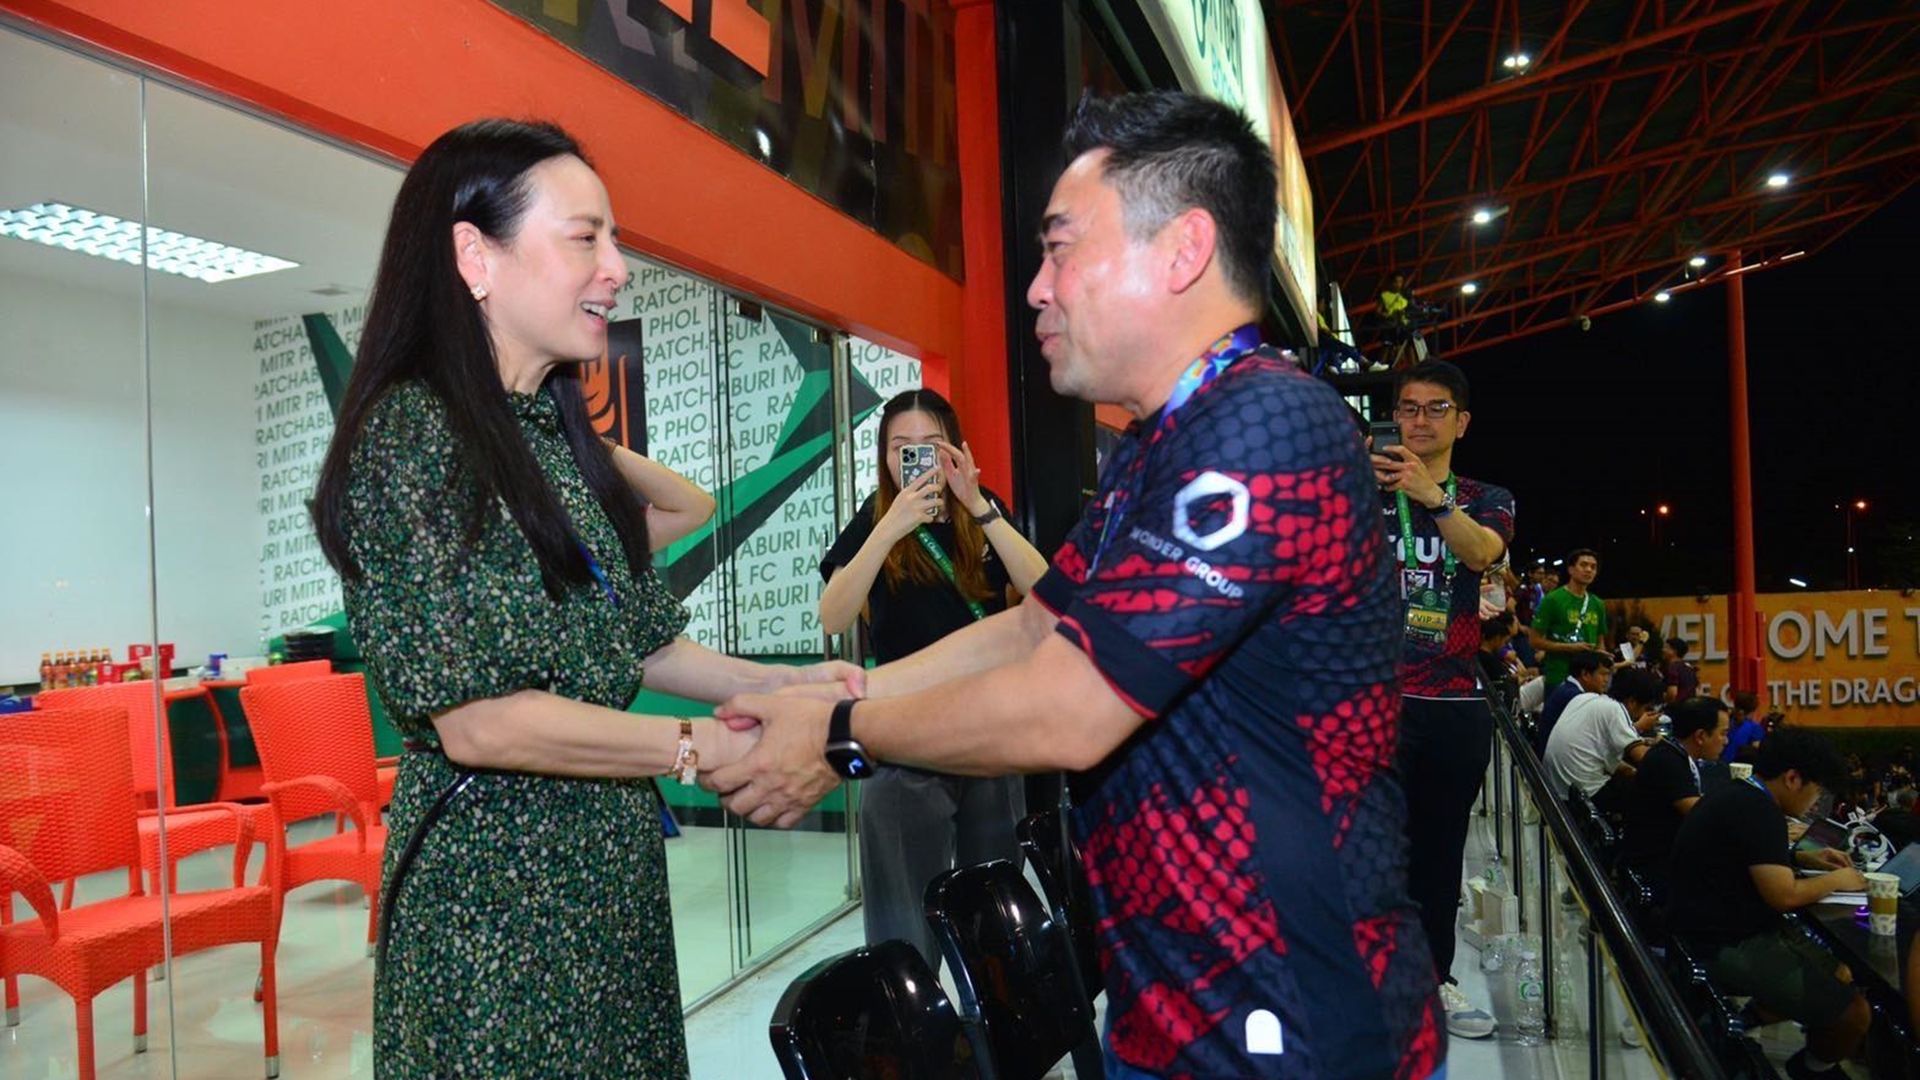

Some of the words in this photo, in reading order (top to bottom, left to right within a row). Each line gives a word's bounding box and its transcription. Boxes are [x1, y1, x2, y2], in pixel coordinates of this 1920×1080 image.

[650, 305, 701, 337] PHOL
[261, 349, 296, 374] MITR
[657, 358, 710, 389] PHOL
[759, 339, 791, 363] RA
[266, 394, 301, 420] MITR
[664, 412, 718, 440] PHO
[767, 390, 799, 416] RA
[273, 440, 307, 465] MITR
[750, 562, 777, 586] FC
[1185, 556, 1245, 599] GROUP
[291, 578, 326, 602] MITR
[759, 616, 785, 640] FC
[1766, 679, 1823, 707] THE
[1830, 676, 1920, 706] DRAG
